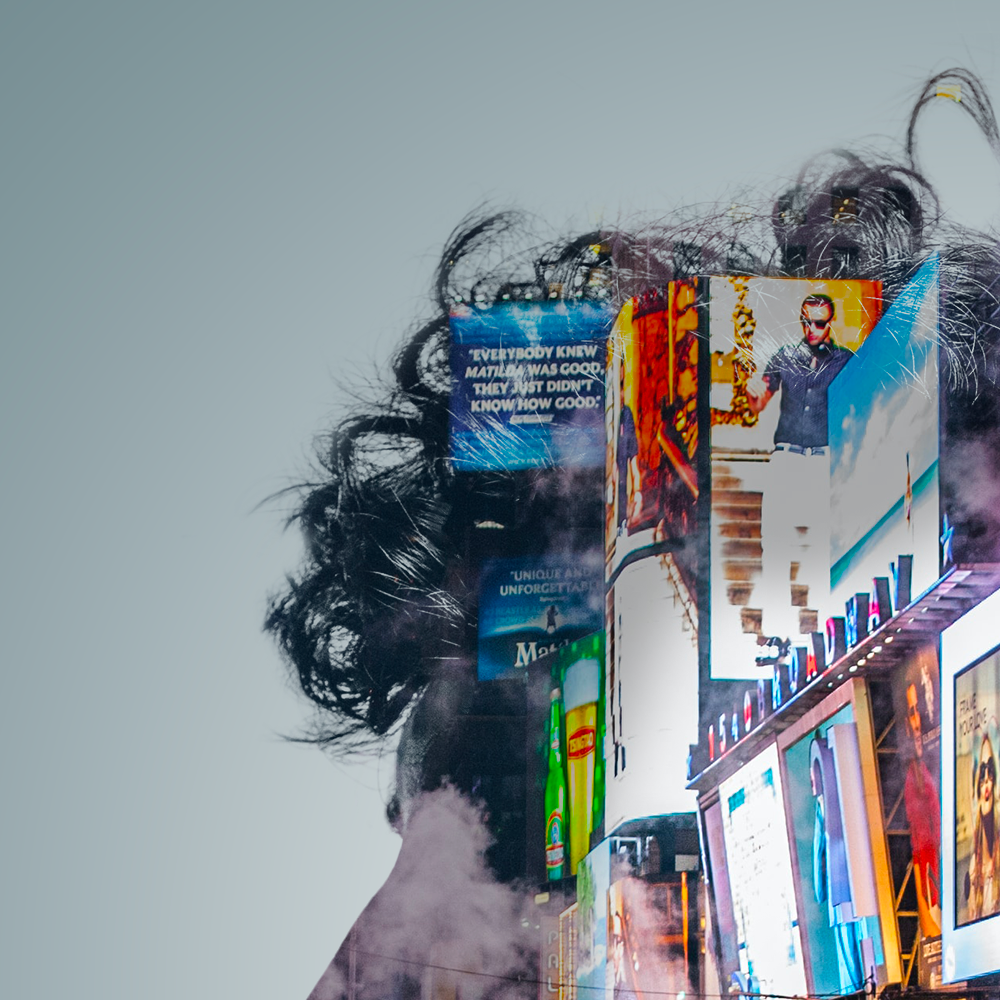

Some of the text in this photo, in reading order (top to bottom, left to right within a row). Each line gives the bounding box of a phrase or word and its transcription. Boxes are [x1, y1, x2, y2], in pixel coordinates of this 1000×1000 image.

[556, 345, 598, 358] KNEW
[465, 362, 605, 379] MATILDA WAS GOOD,
[473, 379, 594, 395] THEY JUST DIDN'T
[471, 399, 515, 413] KNOW
[517, 397, 552, 411] HOW
